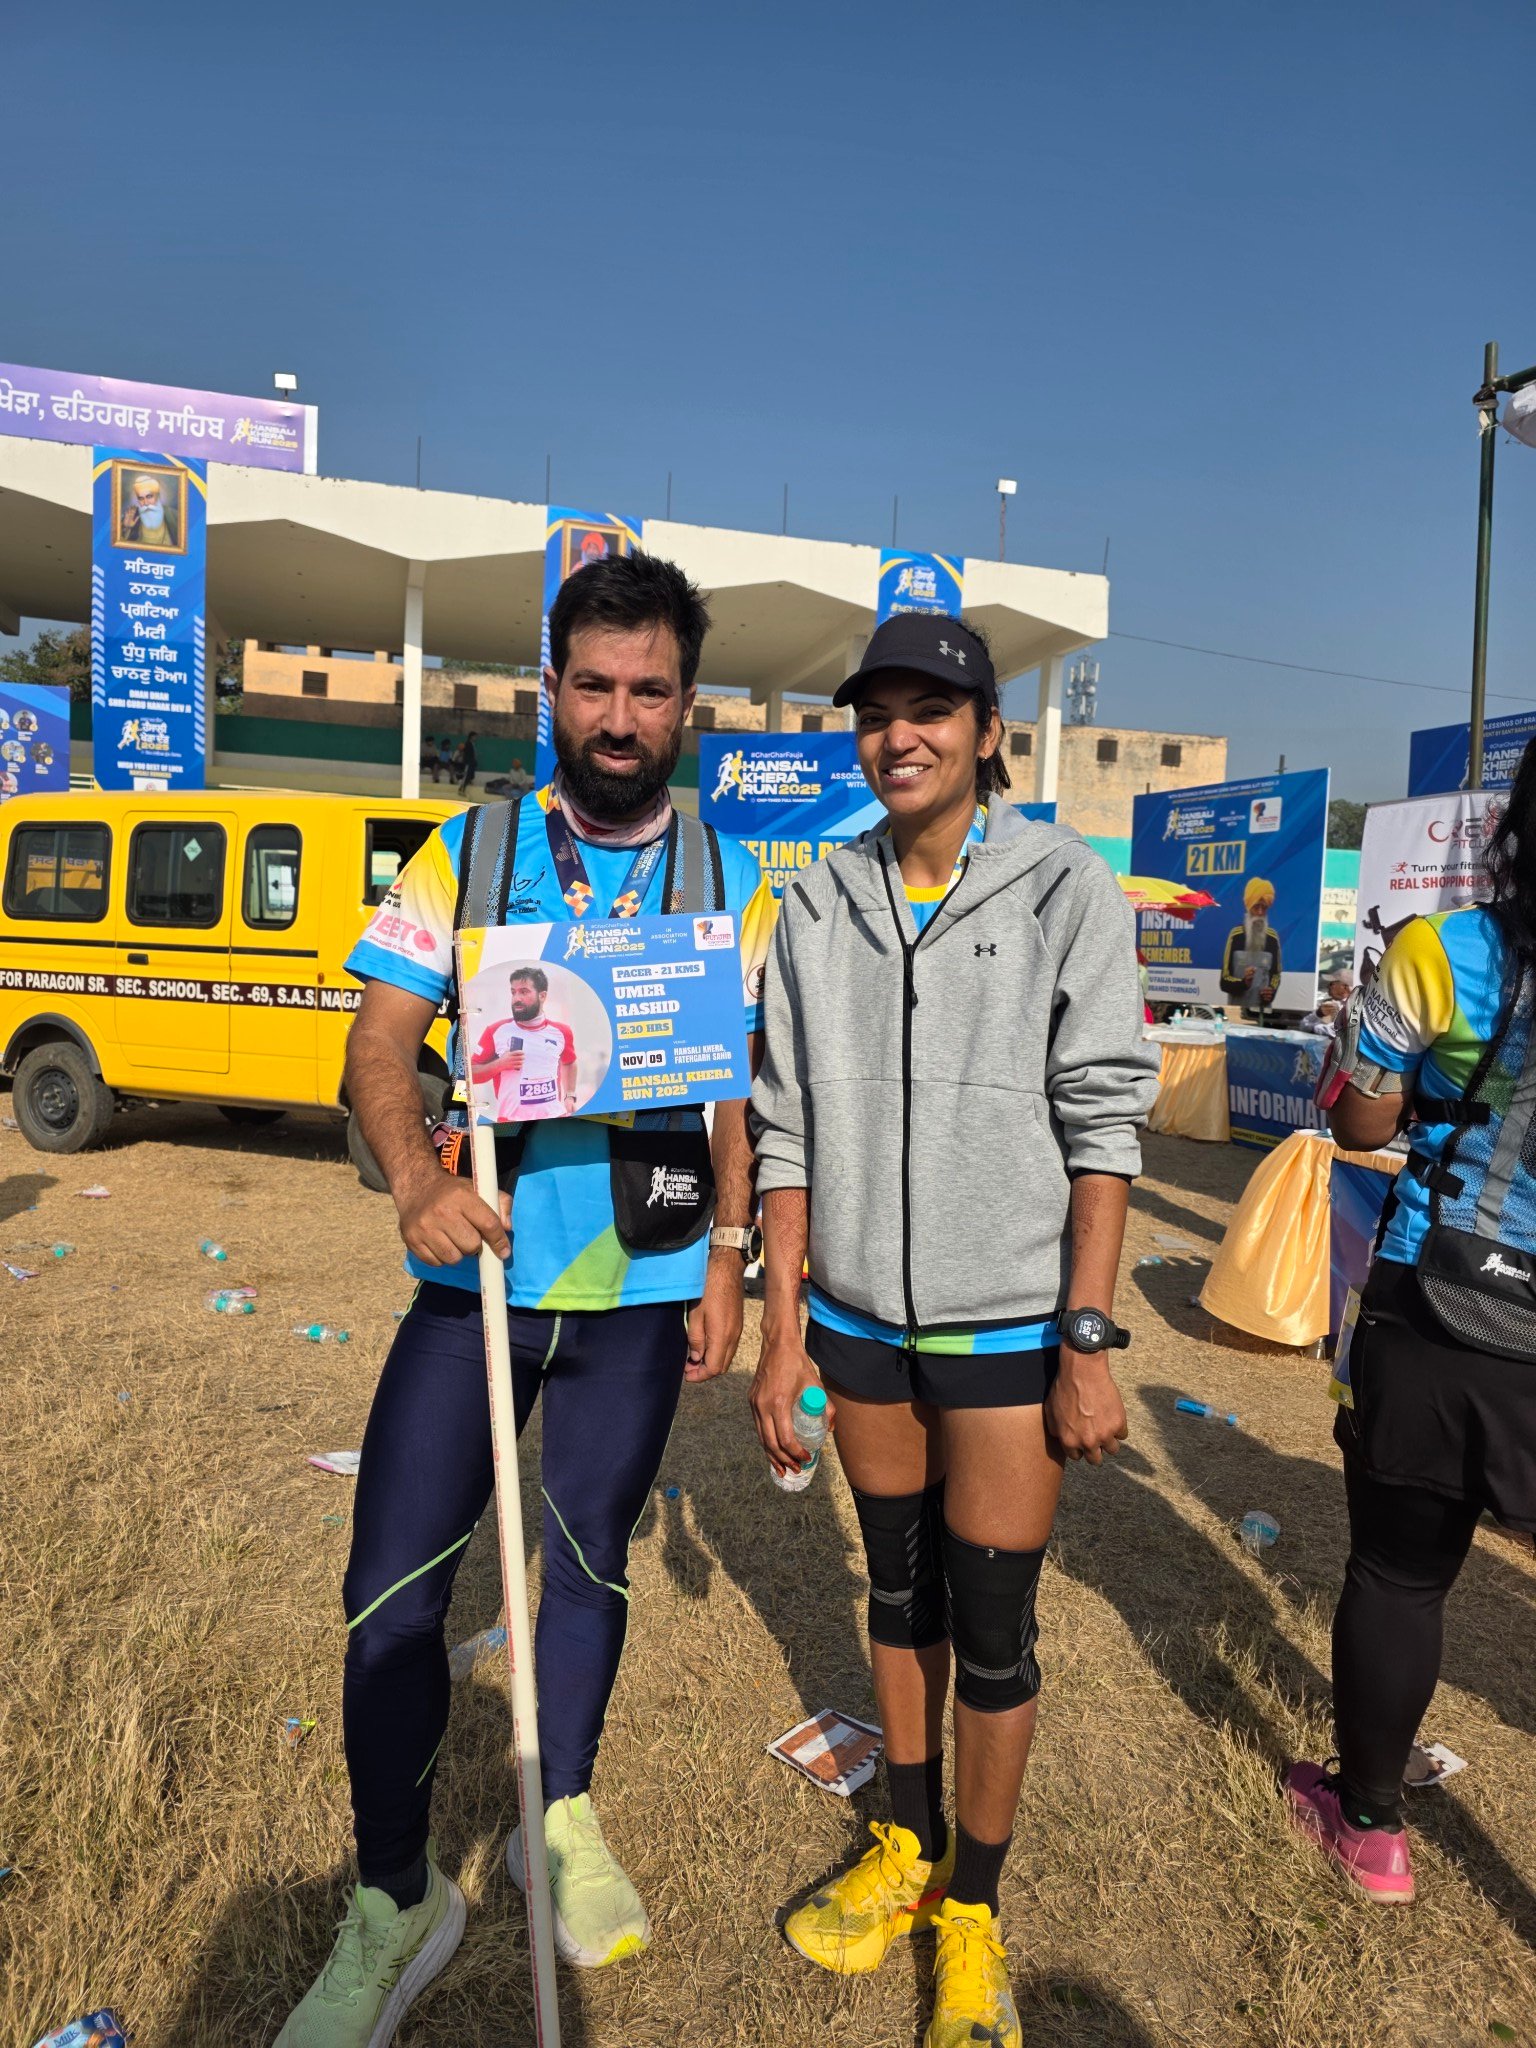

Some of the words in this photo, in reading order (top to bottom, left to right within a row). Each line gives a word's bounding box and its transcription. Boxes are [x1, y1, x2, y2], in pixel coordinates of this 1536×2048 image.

[156, 404, 226, 440] ਸਾਹਿਬ
[124, 557, 176, 580] ਸਤਿਗੁਰ
[129, 582, 170, 598] ਨਾਨਕ
[120, 601, 179, 619] ਪ੍ਰਗਟਿਆ
[133, 621, 166, 640] ਮਿਟੀ
[148, 645, 178, 663] ਜਗਿ
[743, 760, 818, 772] HANSALI
[743, 772, 799, 783] KHERA
[743, 783, 777, 795] RUN
[778, 784, 821, 795] 2025
[1180, 810, 1215, 820] HANSALI
[1190, 846, 1209, 872] 21
[1213, 843, 1241, 871] KM
[1411, 863, 1438, 873] Turn
[1441, 863, 1458, 873] your
[1390, 878, 1419, 890] REAL
[1422, 876, 1475, 889] SHOPPING
[586, 927, 641, 939] HANSALI
[1141, 931, 1159, 946] RUN
[1162, 931, 1173, 946] TO
[586, 936, 629, 946] KHERA
[587, 945, 614, 954] RUN
[613, 942, 646, 952] 2025
[616, 968, 652, 979] PACER
[660, 966, 673, 975] 21
[675, 964, 700, 974] KMS
[0, 971, 22, 987] FOR
[25, 972, 84, 991] PARAGON
[88, 976, 108, 992] SR.
[116, 978, 146, 995] SEC.
[149, 980, 208, 1003] SCHOOL,
[212, 984, 244, 1002] SEC.
[614, 983, 666, 1000] UMER
[615, 1000, 680, 1018] RASHID
[620, 1024, 643, 1035] 2:30
[646, 1022, 670, 1033] HRS
[673, 1046, 700, 1056] HANSALI
[702, 1044, 725, 1054] KHERA,
[712, 1051, 732, 1061] SAHIB
[622, 1055, 644, 1067] NOV
[649, 1053, 663, 1064] 09
[621, 1072, 683, 1089] HANSALI
[686, 1068, 733, 1082] KHERA
[525, 1081, 554, 1097] 2861
[622, 1088, 653, 1101] RUN
[655, 1085, 688, 1098] 2025
[666, 1182, 692, 1192] KHERA
[666, 1191, 683, 1200] RUN
[683, 1191, 700, 1200] 2025
[54, 2029, 81, 2046] Milk
